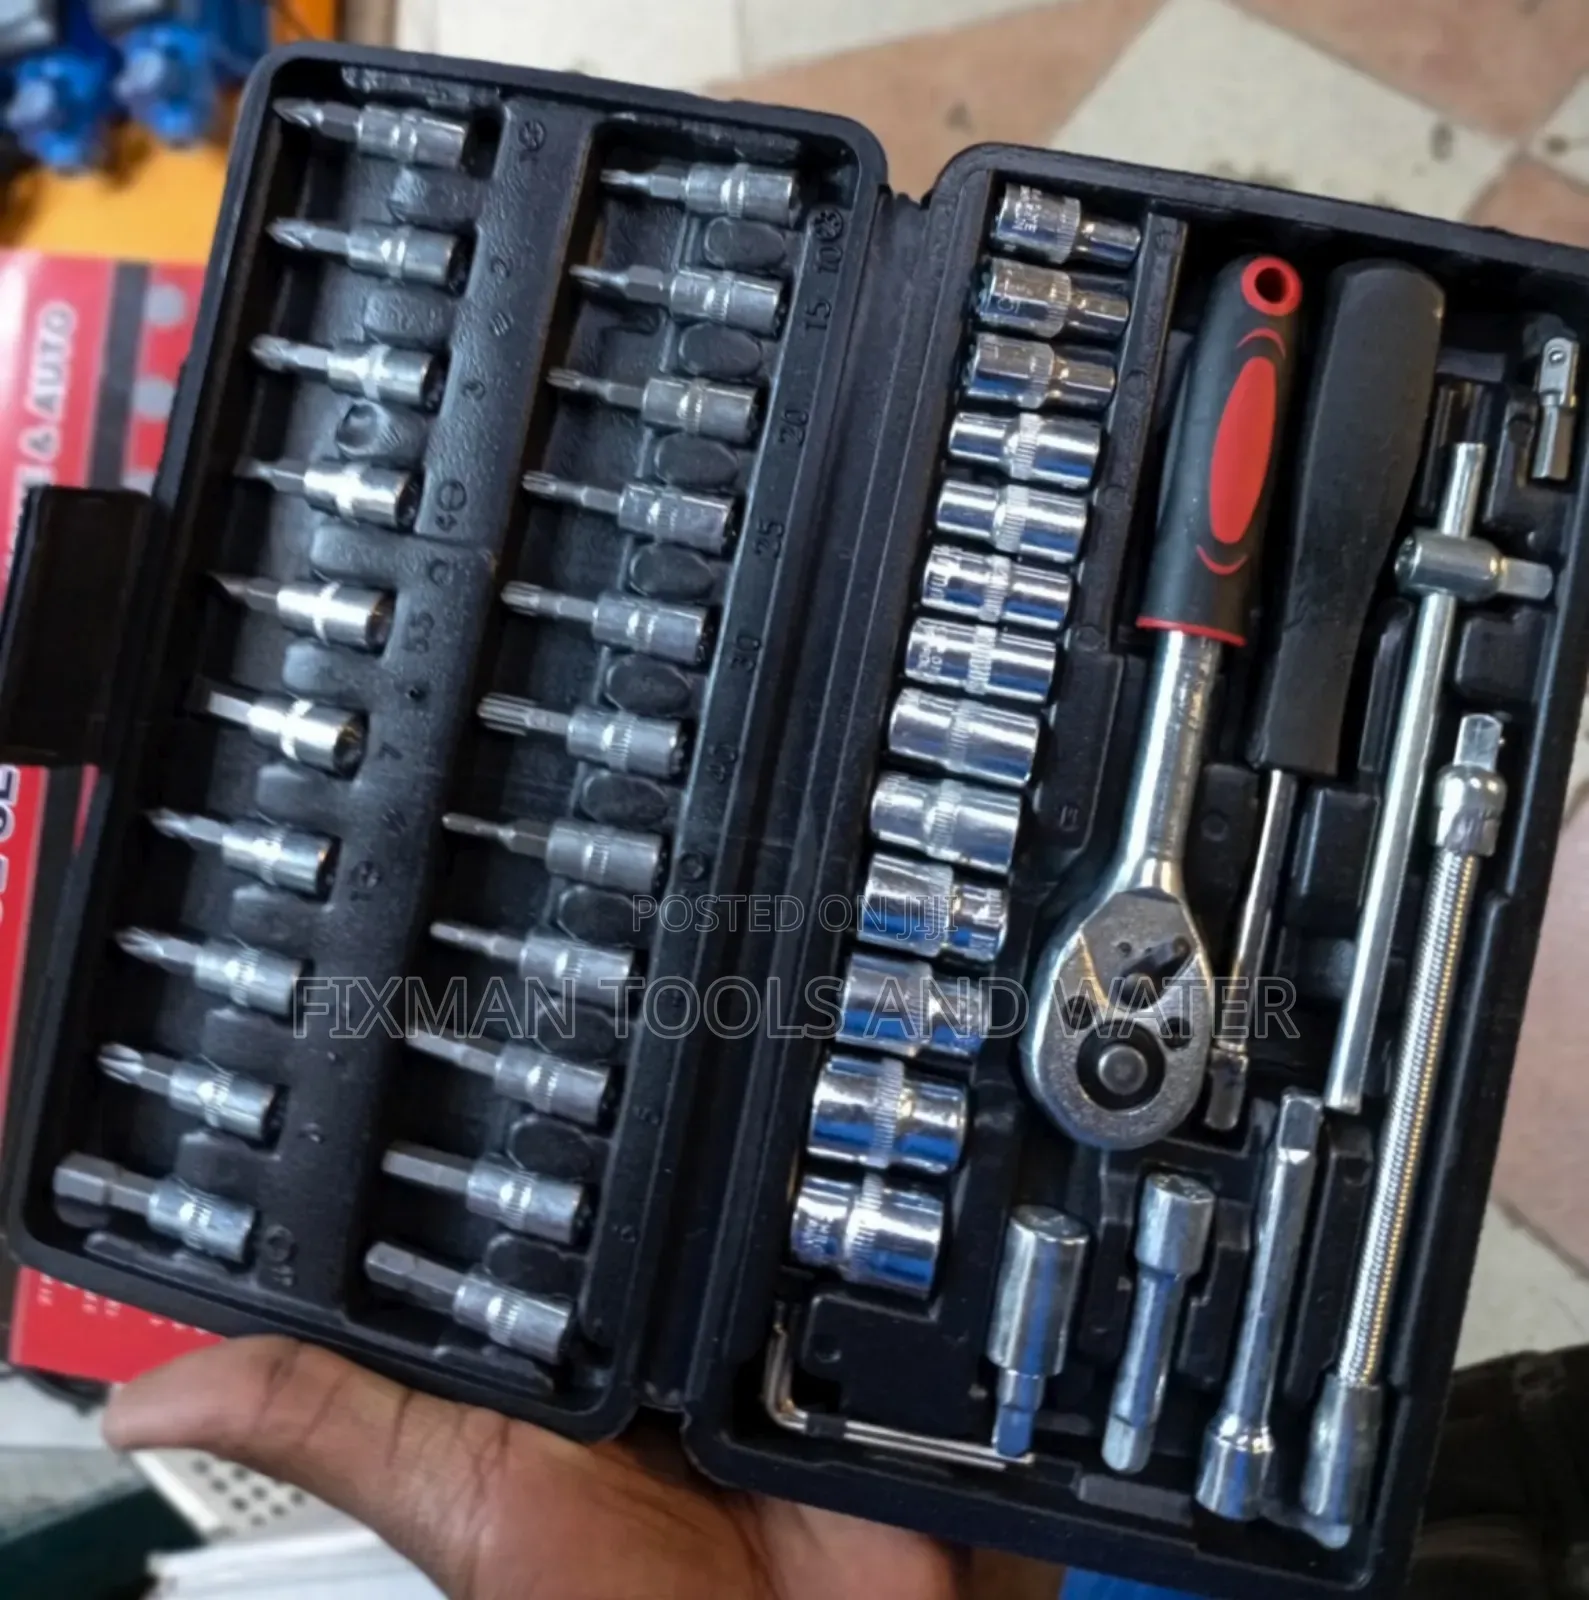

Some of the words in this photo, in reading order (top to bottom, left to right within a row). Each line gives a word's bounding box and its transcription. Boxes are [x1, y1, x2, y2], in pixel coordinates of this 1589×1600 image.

[813, 246, 844, 276] 10
[804, 298, 834, 332] 15
[27, 299, 77, 420] AUTO
[777, 408, 810, 449] 20
[754, 518, 786, 560] 25
